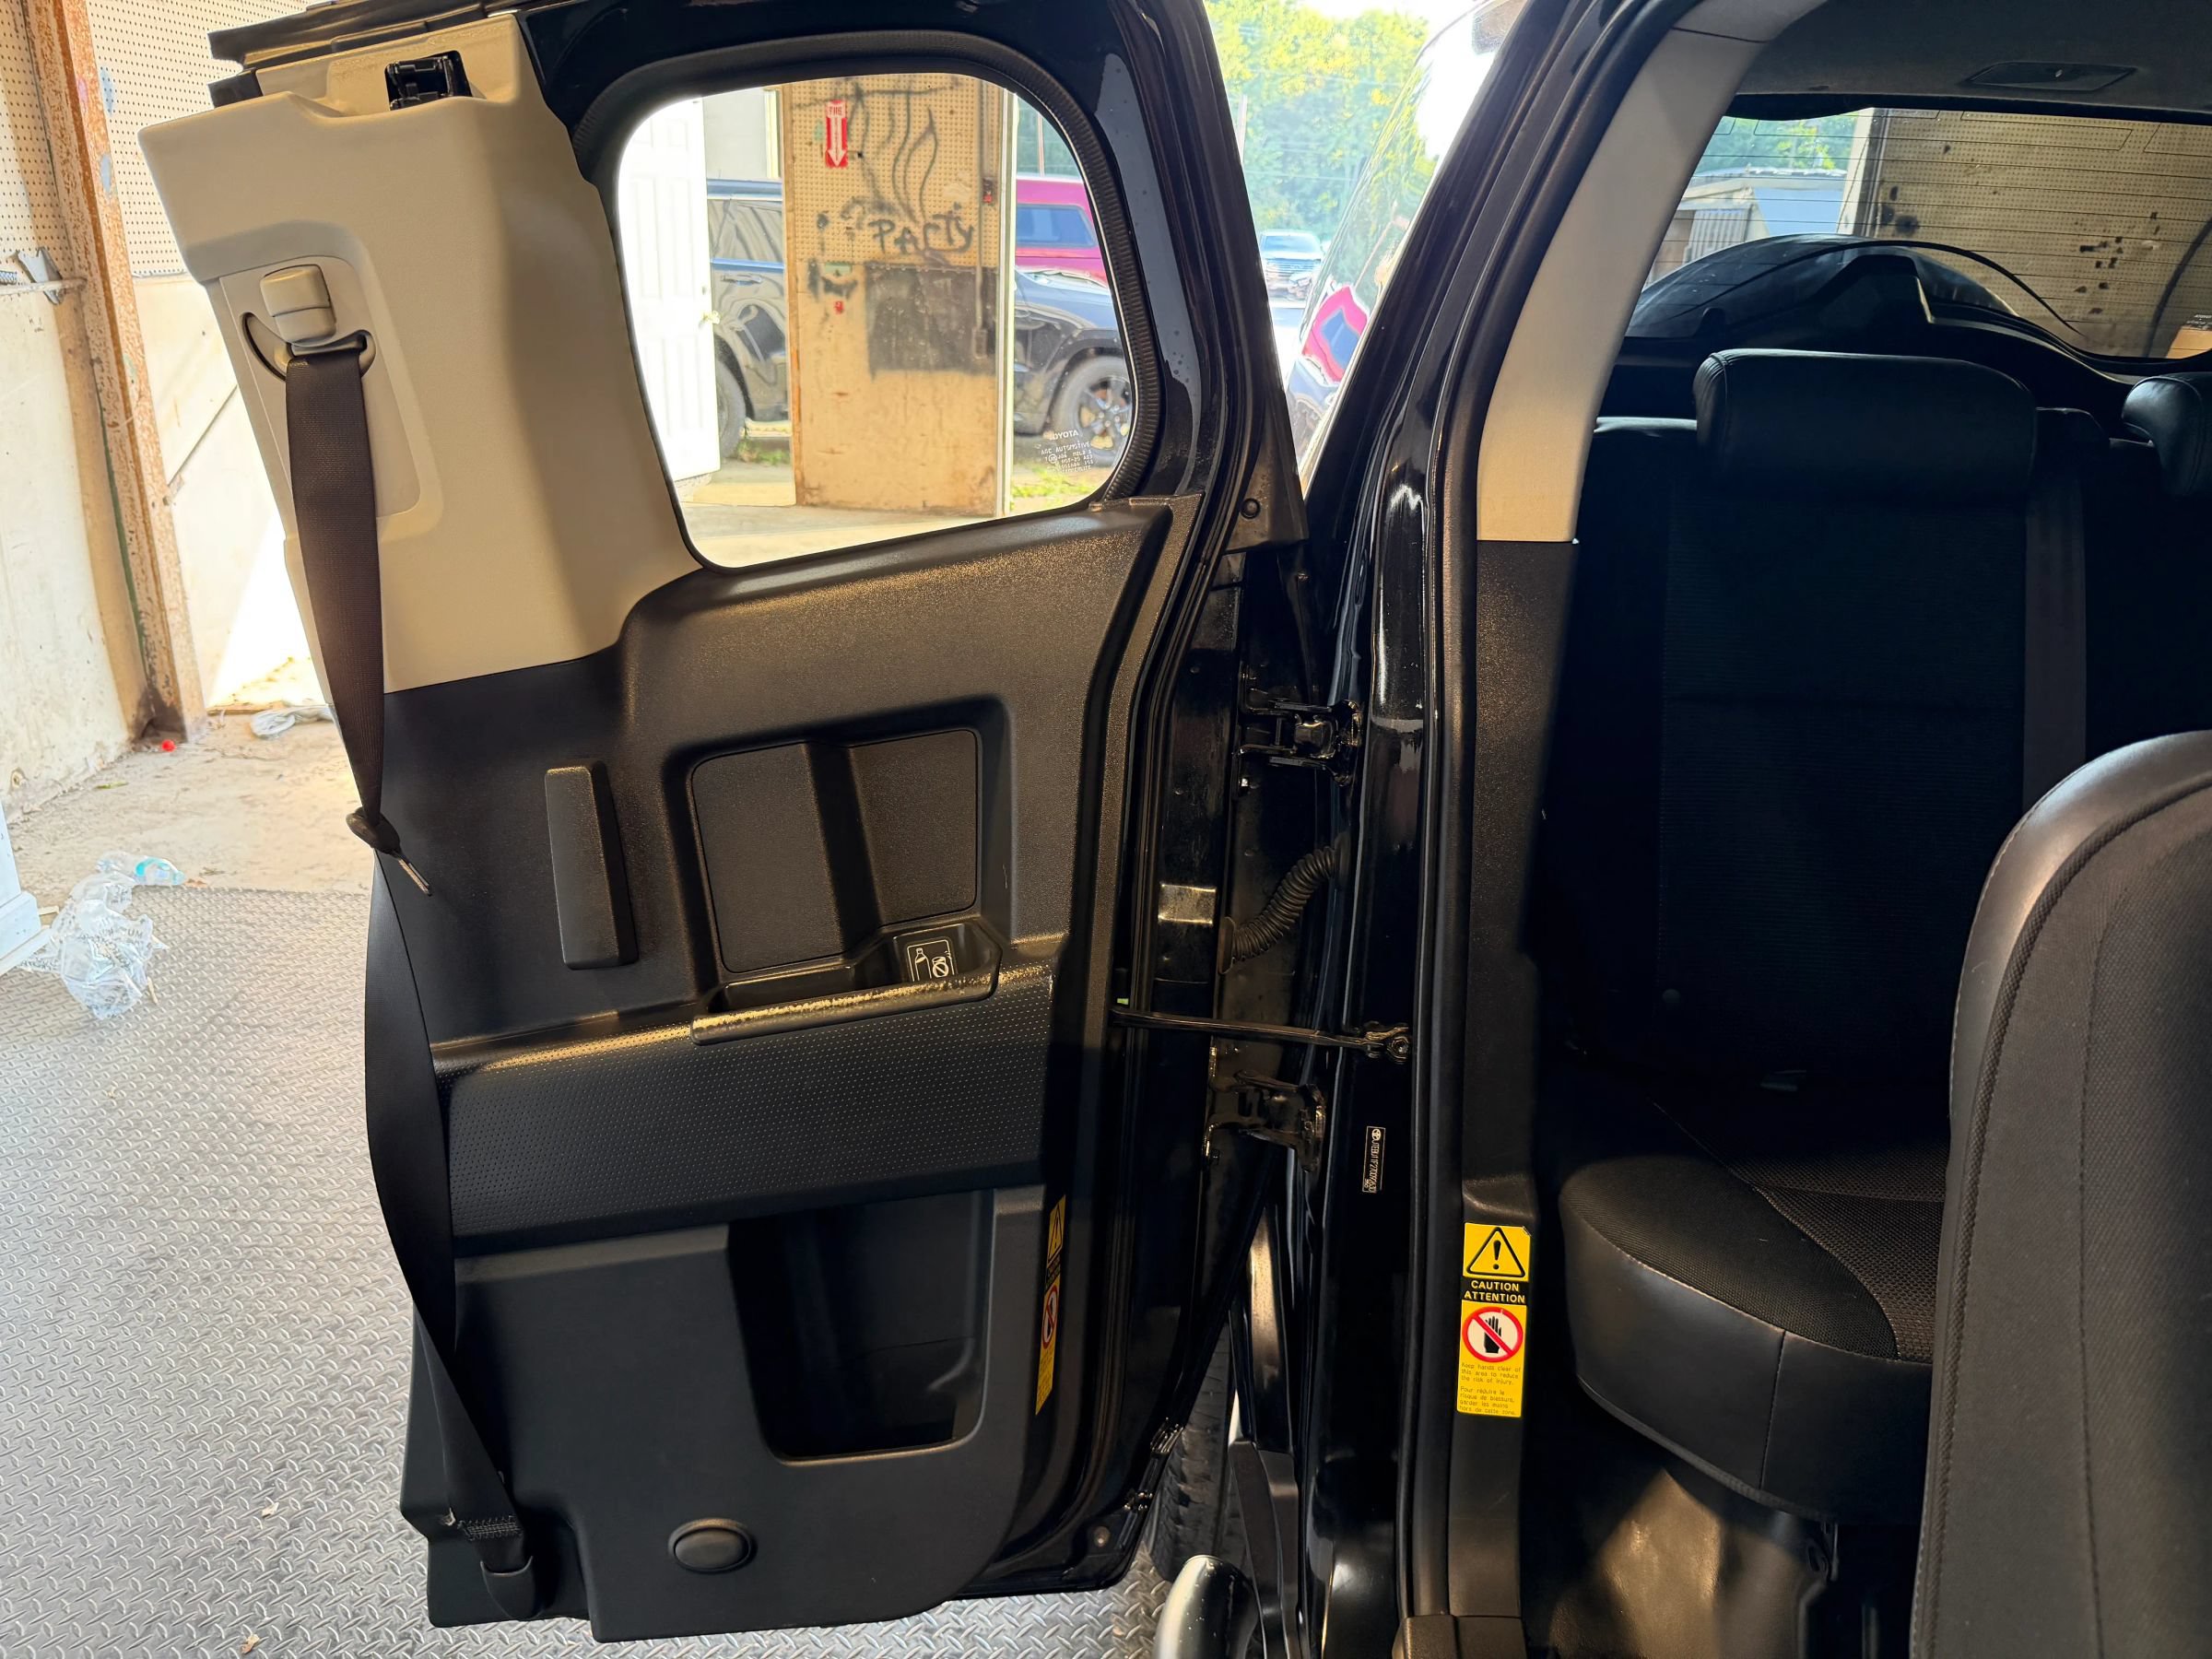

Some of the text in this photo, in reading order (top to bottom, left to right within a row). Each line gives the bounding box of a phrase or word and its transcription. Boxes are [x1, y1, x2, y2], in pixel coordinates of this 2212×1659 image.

[1050, 429, 1079, 440] OYOTA
[1470, 1280, 1520, 1292] CAUTION
[1464, 1289, 1525, 1303] ATTENTION
